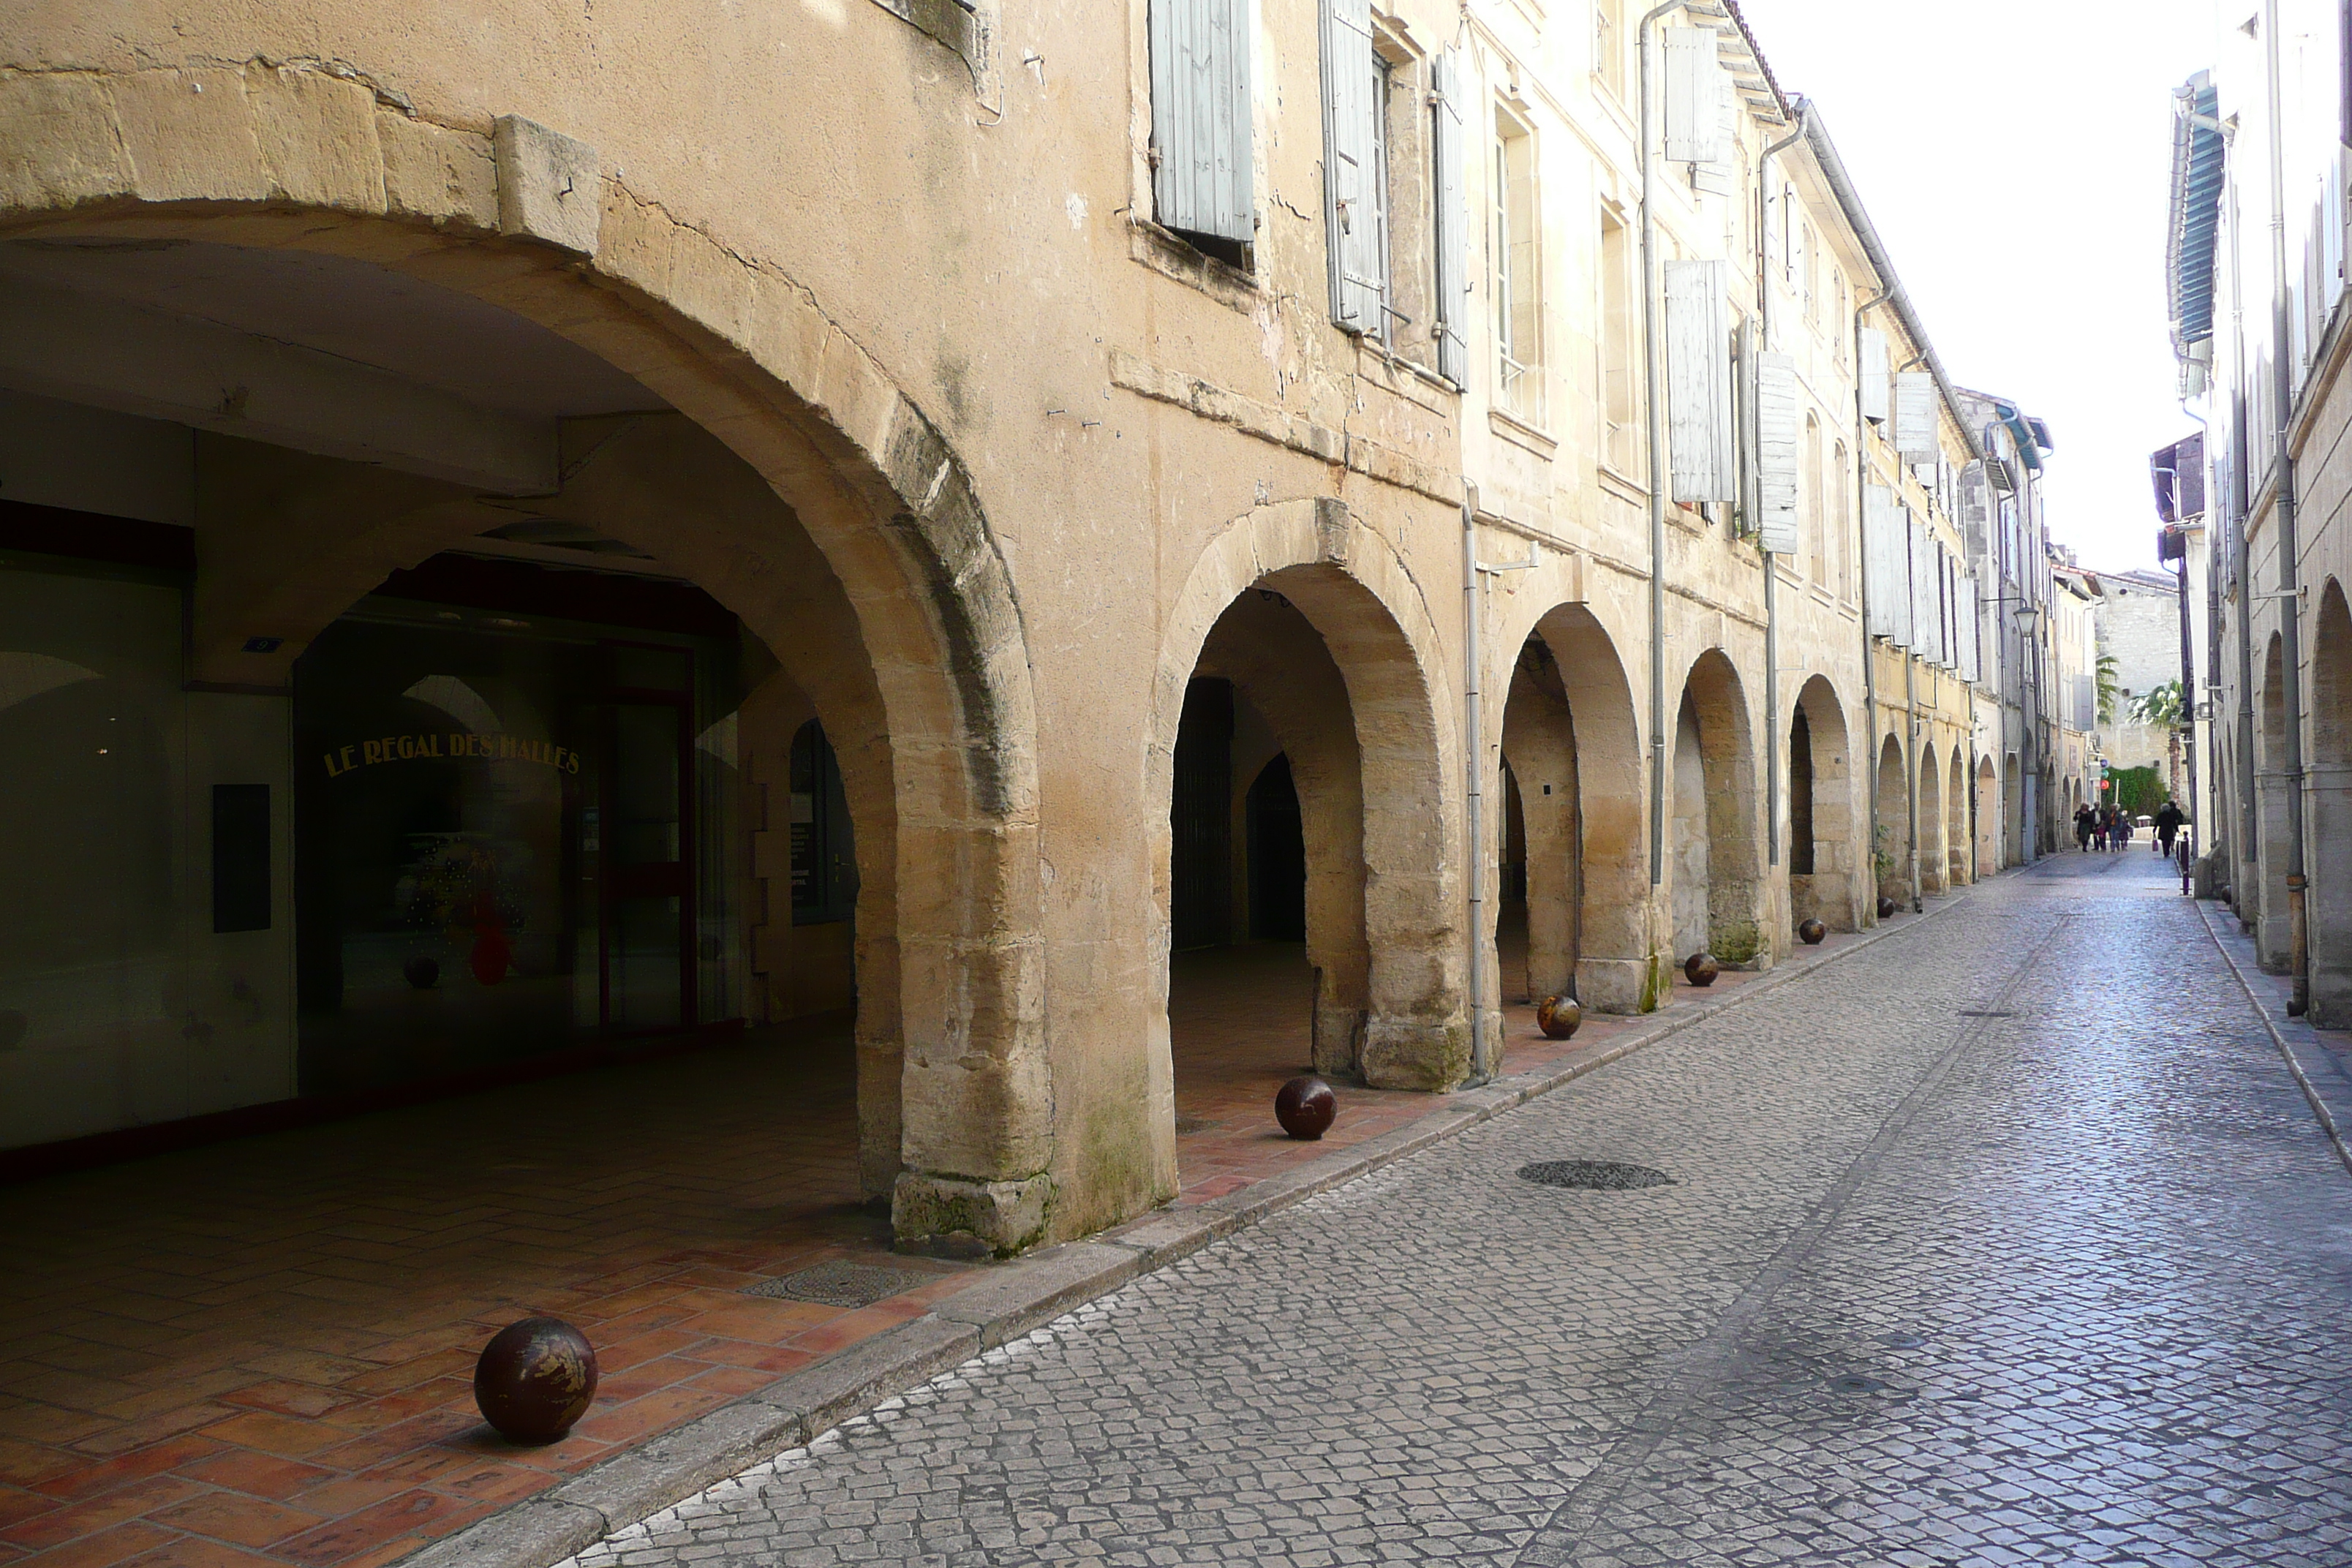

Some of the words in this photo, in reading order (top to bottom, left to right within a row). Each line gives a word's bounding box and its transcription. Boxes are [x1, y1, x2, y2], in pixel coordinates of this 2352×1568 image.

[257, 640, 268, 649] 9
[324, 745, 358, 778] LE
[363, 734, 444, 764] REGAL
[450, 734, 493, 757] DES
[500, 735, 580, 774] HALLES
